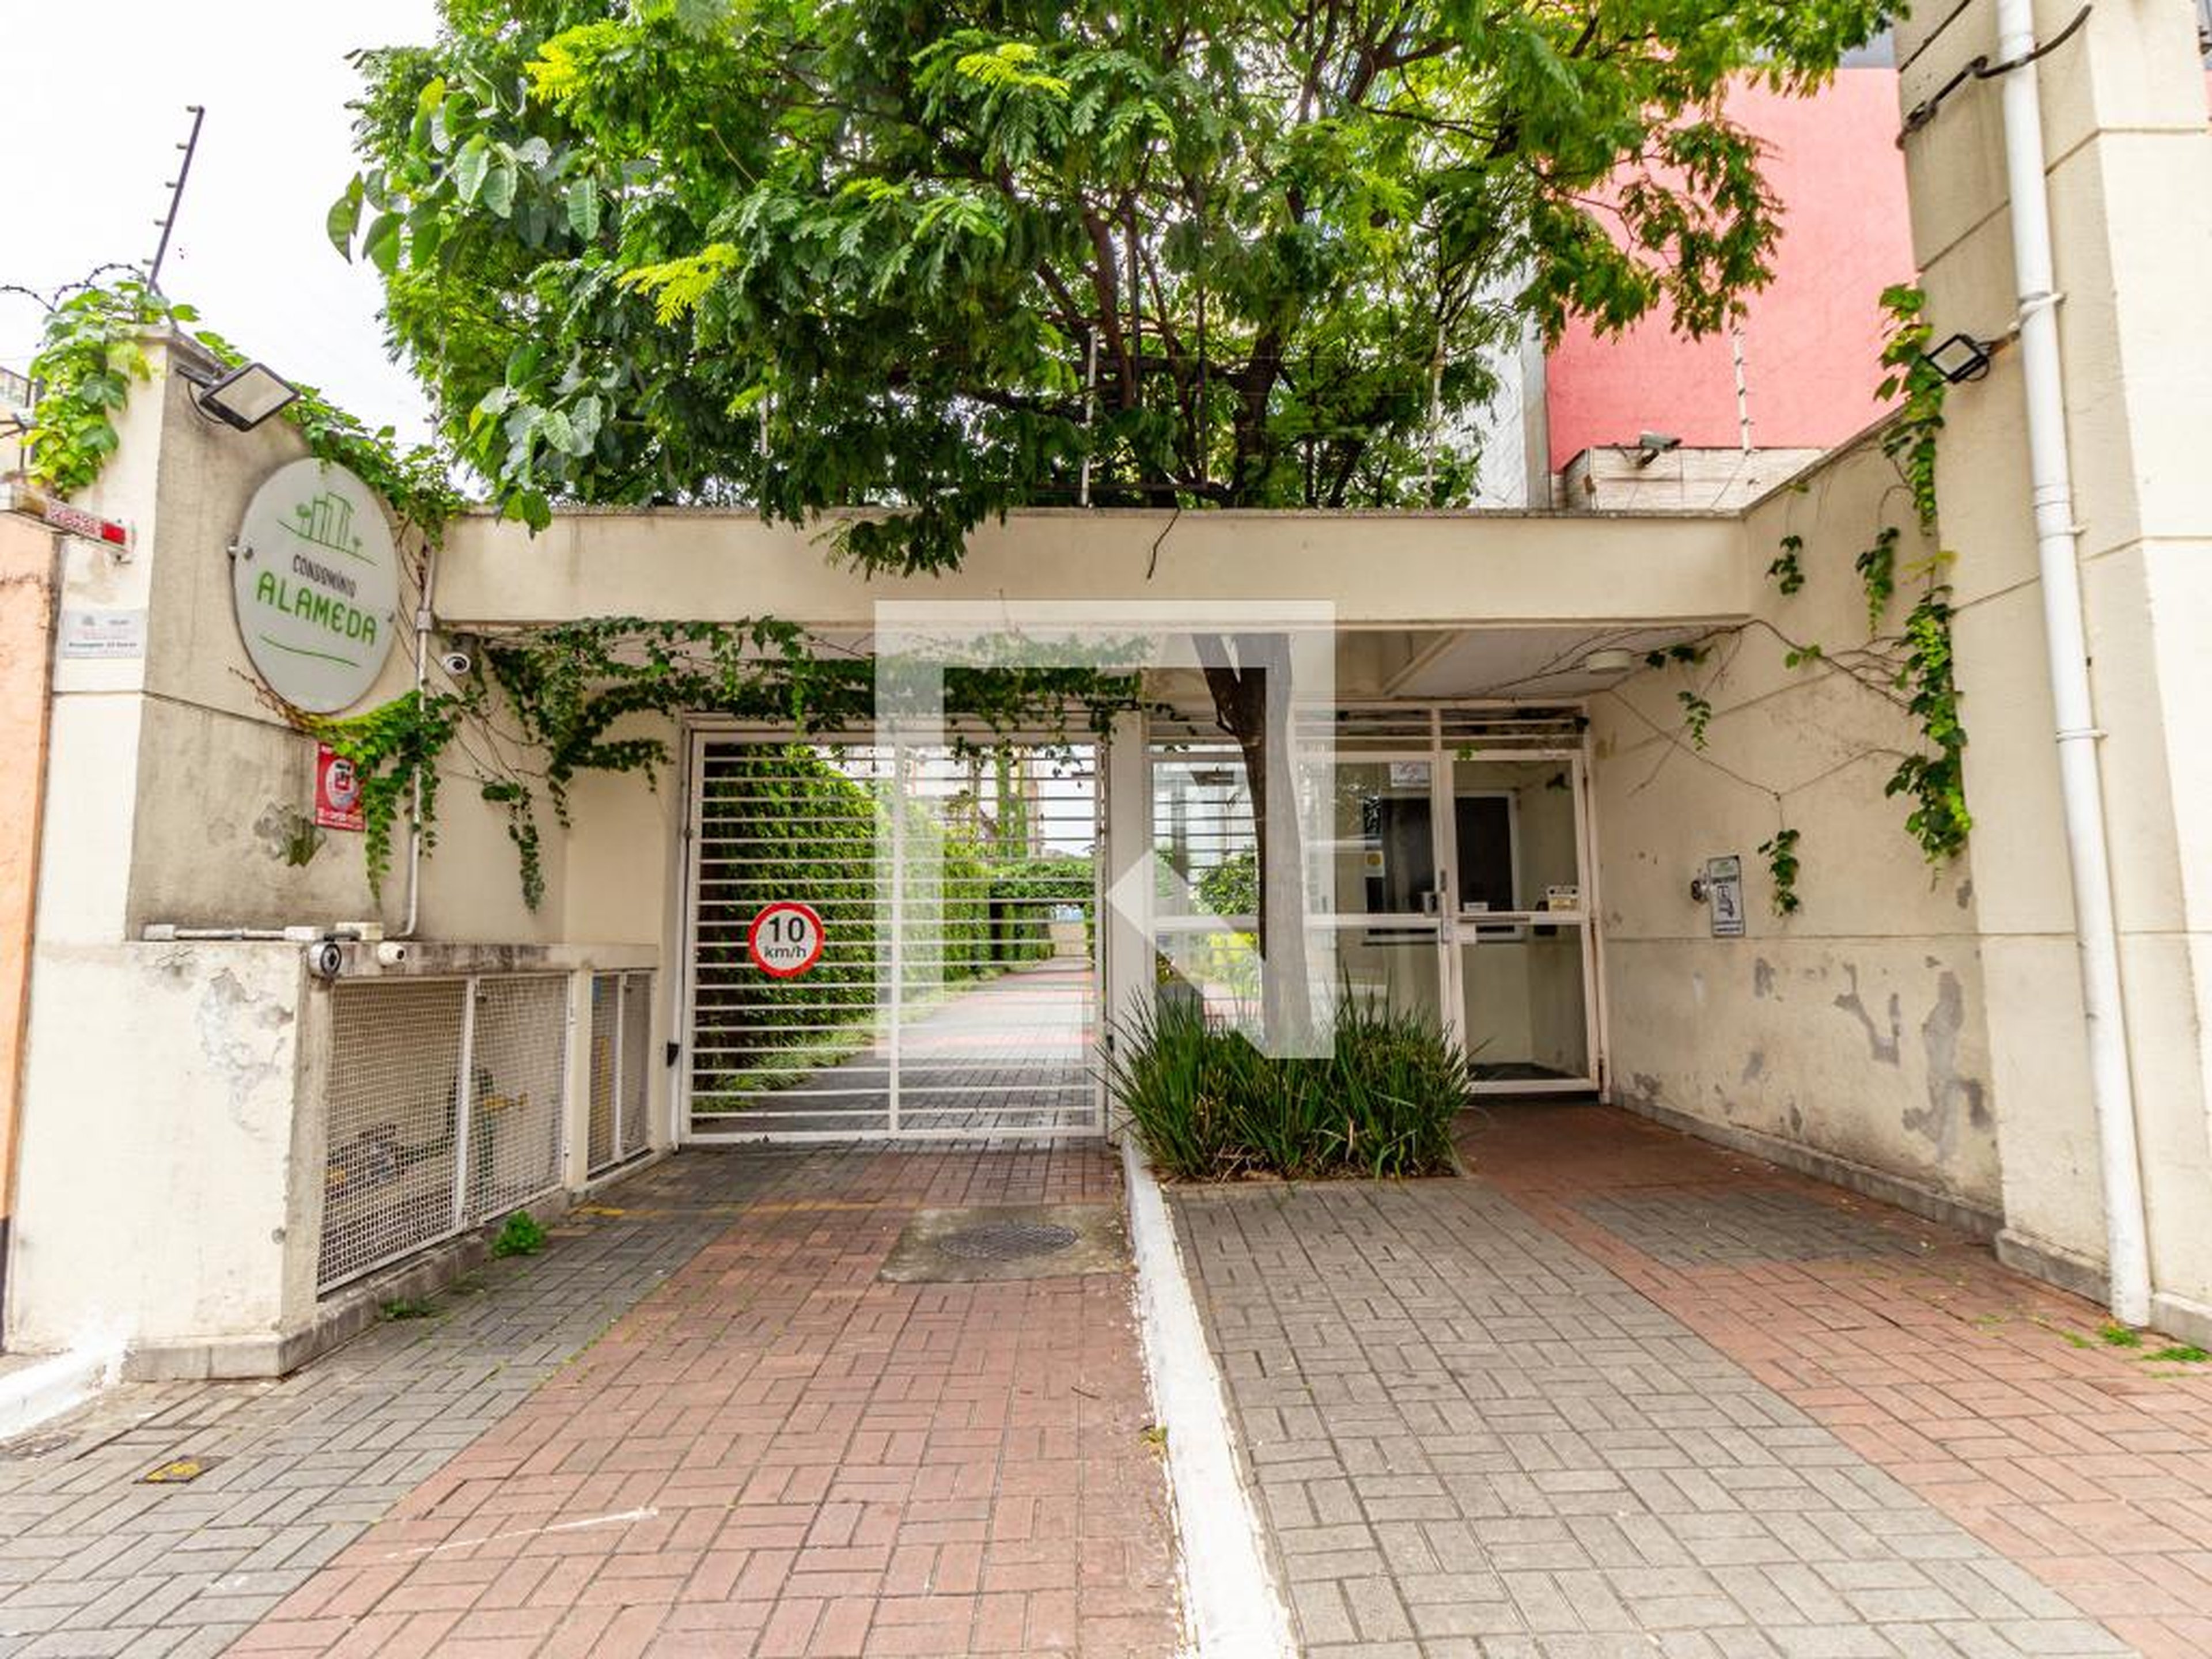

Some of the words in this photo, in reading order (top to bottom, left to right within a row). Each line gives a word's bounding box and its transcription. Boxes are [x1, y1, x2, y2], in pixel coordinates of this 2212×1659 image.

[257, 571, 377, 646] ALAMEDA
[768, 917, 805, 942] 10
[764, 945, 807, 958] km/h
